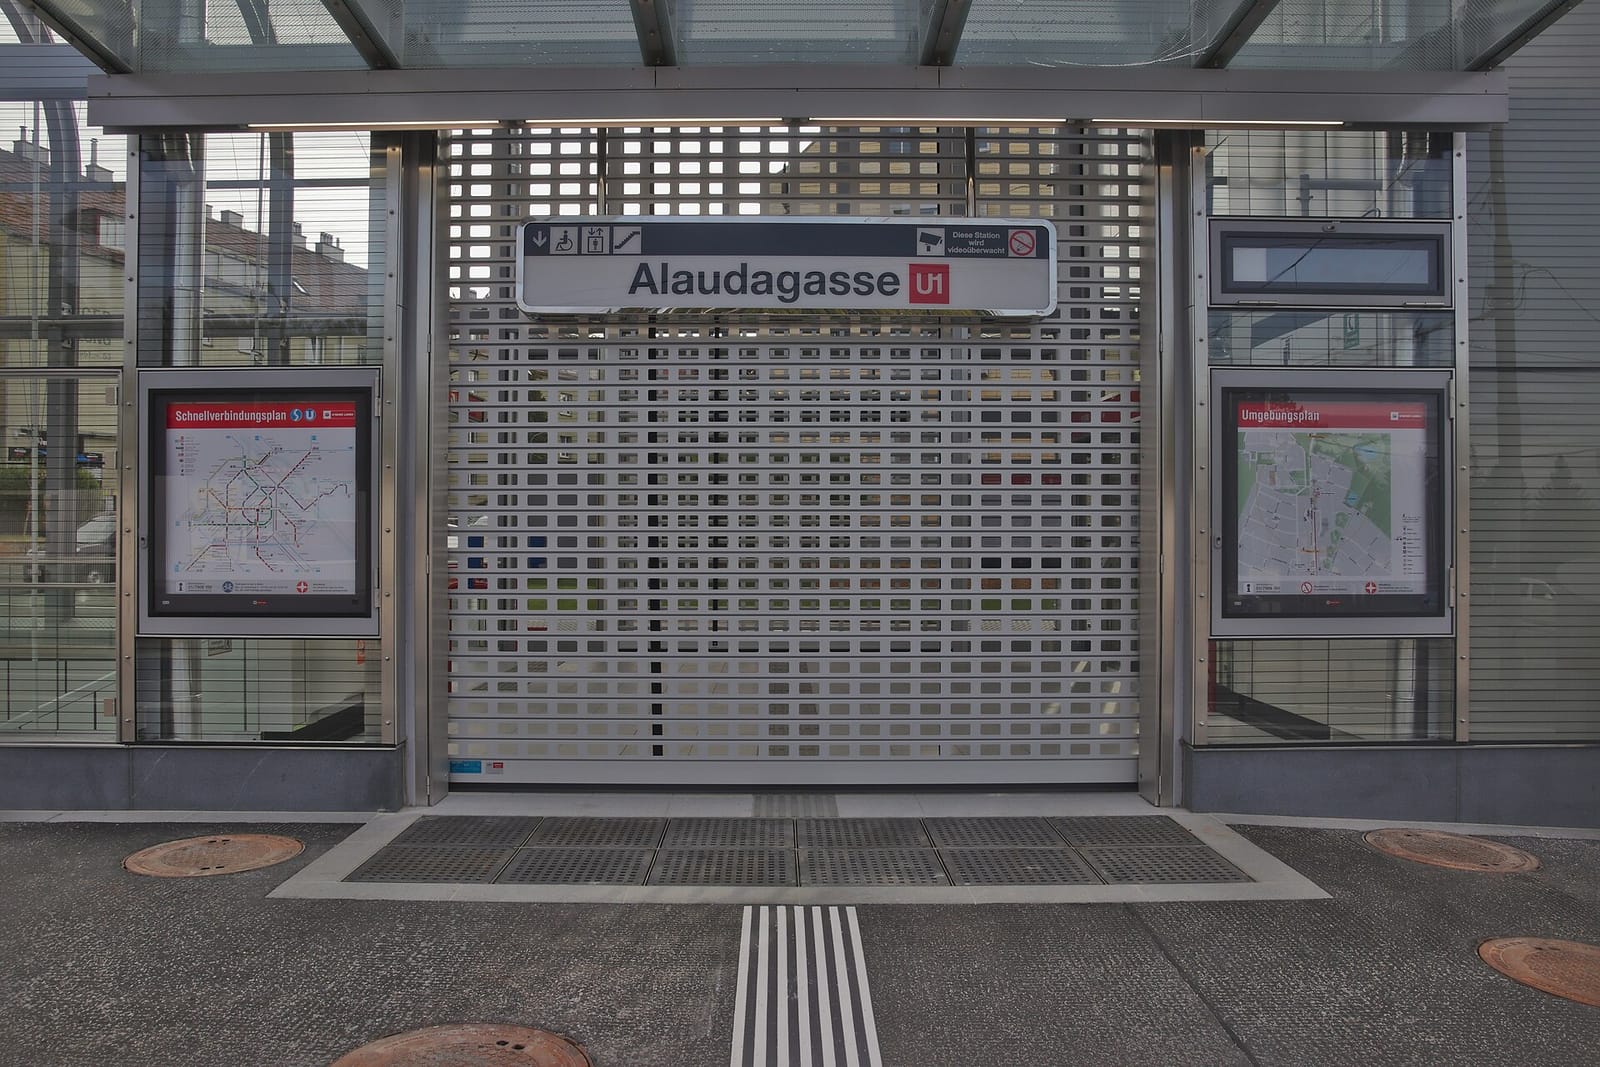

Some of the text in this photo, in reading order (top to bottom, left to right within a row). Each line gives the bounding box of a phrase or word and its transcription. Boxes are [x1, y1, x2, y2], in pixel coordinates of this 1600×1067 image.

[952, 231, 1001, 239] Diese Station
[947, 246, 1005, 254] videoüberwacht
[628, 262, 944, 304] Alaudagasse U1
[175, 409, 287, 423] Schnellverbindungsplan
[1241, 409, 1320, 423] Umgebungsplan
